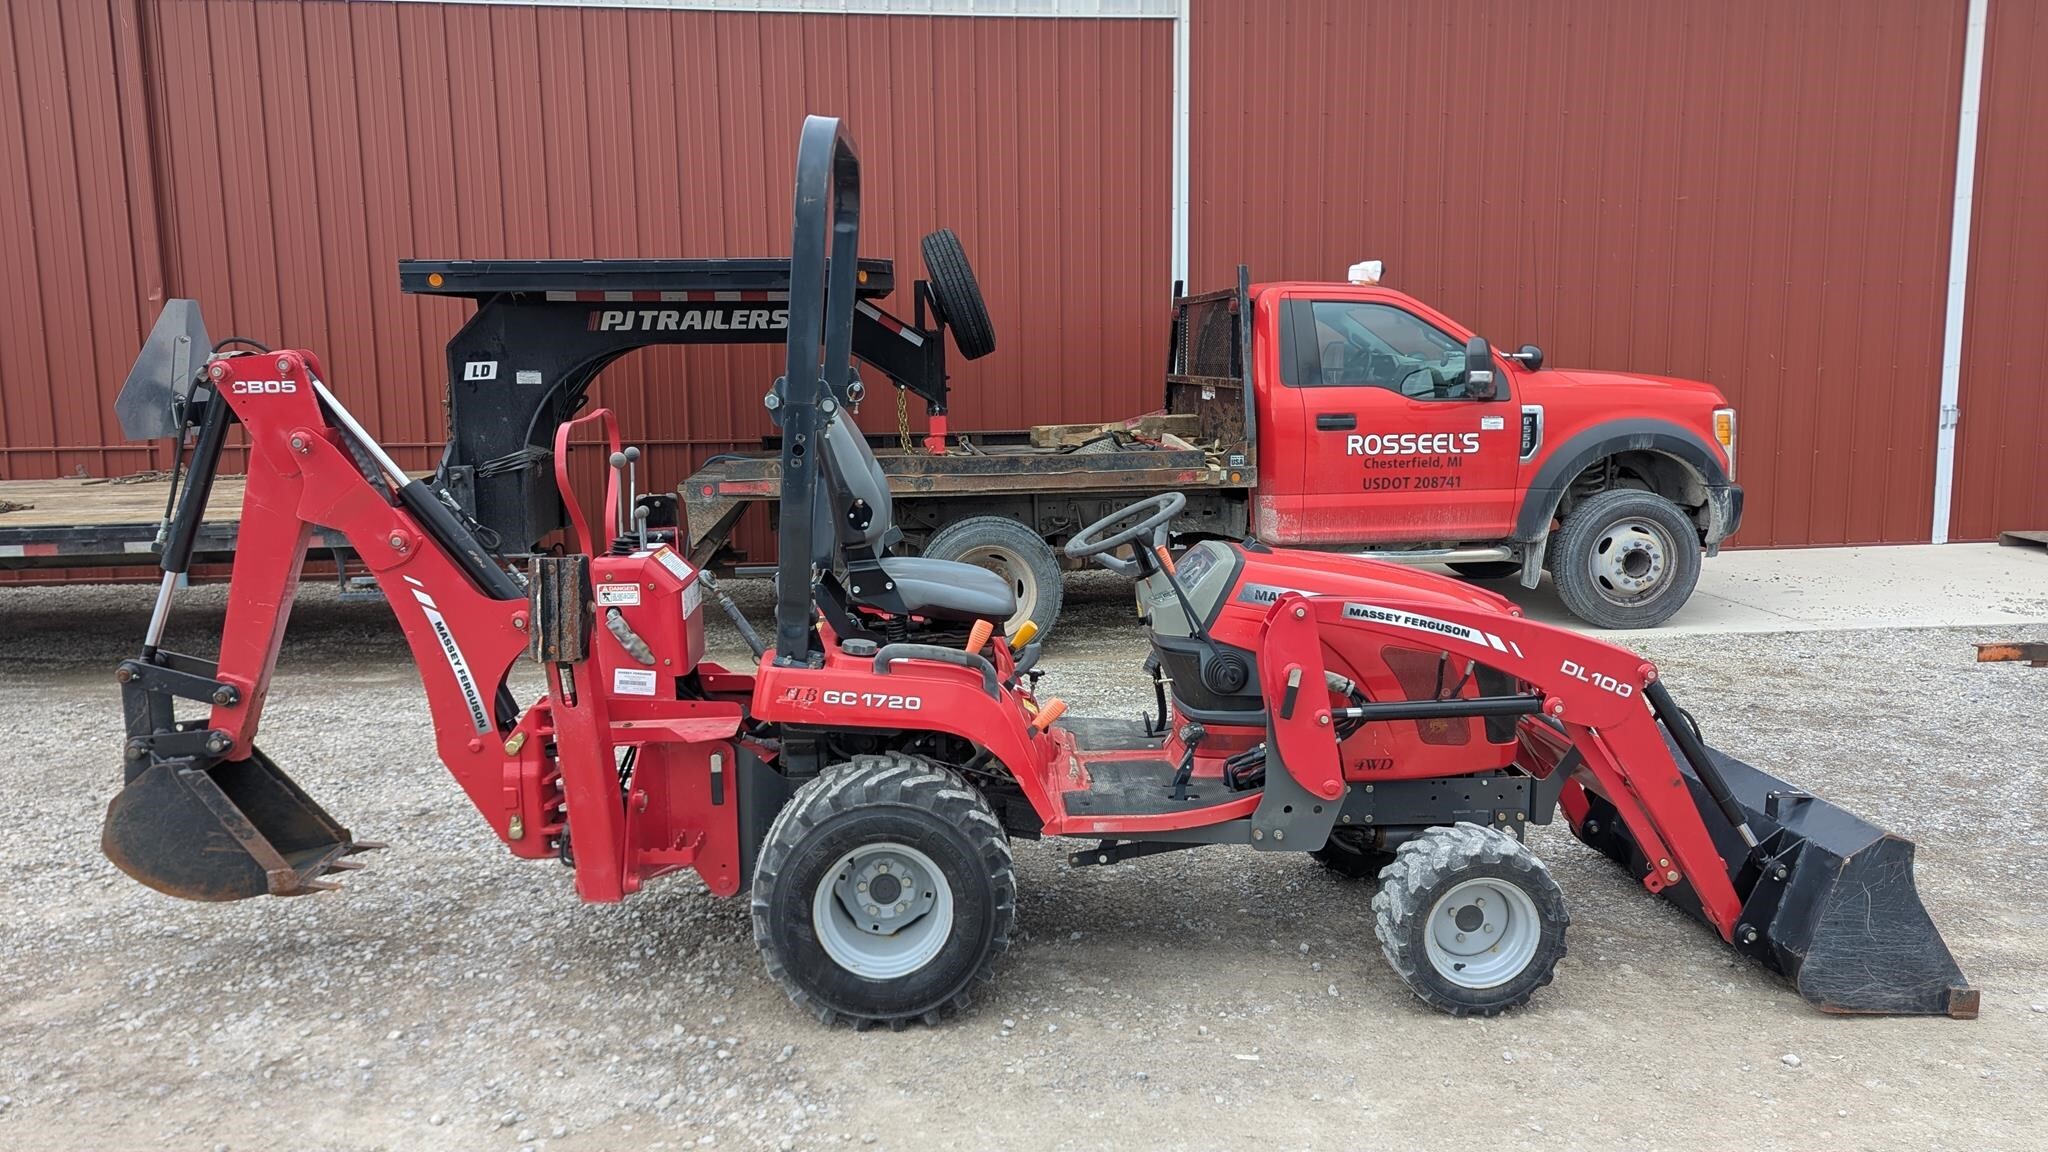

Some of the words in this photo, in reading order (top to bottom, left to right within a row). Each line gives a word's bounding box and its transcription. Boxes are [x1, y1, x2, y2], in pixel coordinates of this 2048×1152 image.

[600, 310, 636, 331] PJ
[638, 309, 789, 331] TRAILERS
[472, 364, 491, 378] LD
[231, 380, 297, 394] CB05
[1346, 432, 1481, 456] ROSSEEL'S
[1363, 457, 1444, 470] Chesterfield,
[1446, 456, 1463, 468] MI
[1362, 477, 1411, 490] USDOT
[1413, 476, 1462, 489] 208741
[1254, 589, 1282, 602] MA
[1349, 607, 1402, 622] MASSEY
[1404, 616, 1471, 638] FERGUSON
[434, 621, 462, 666] MASSEY
[457, 668, 487, 729] FERGUSON
[1354, 758, 1394, 771] 4WD
